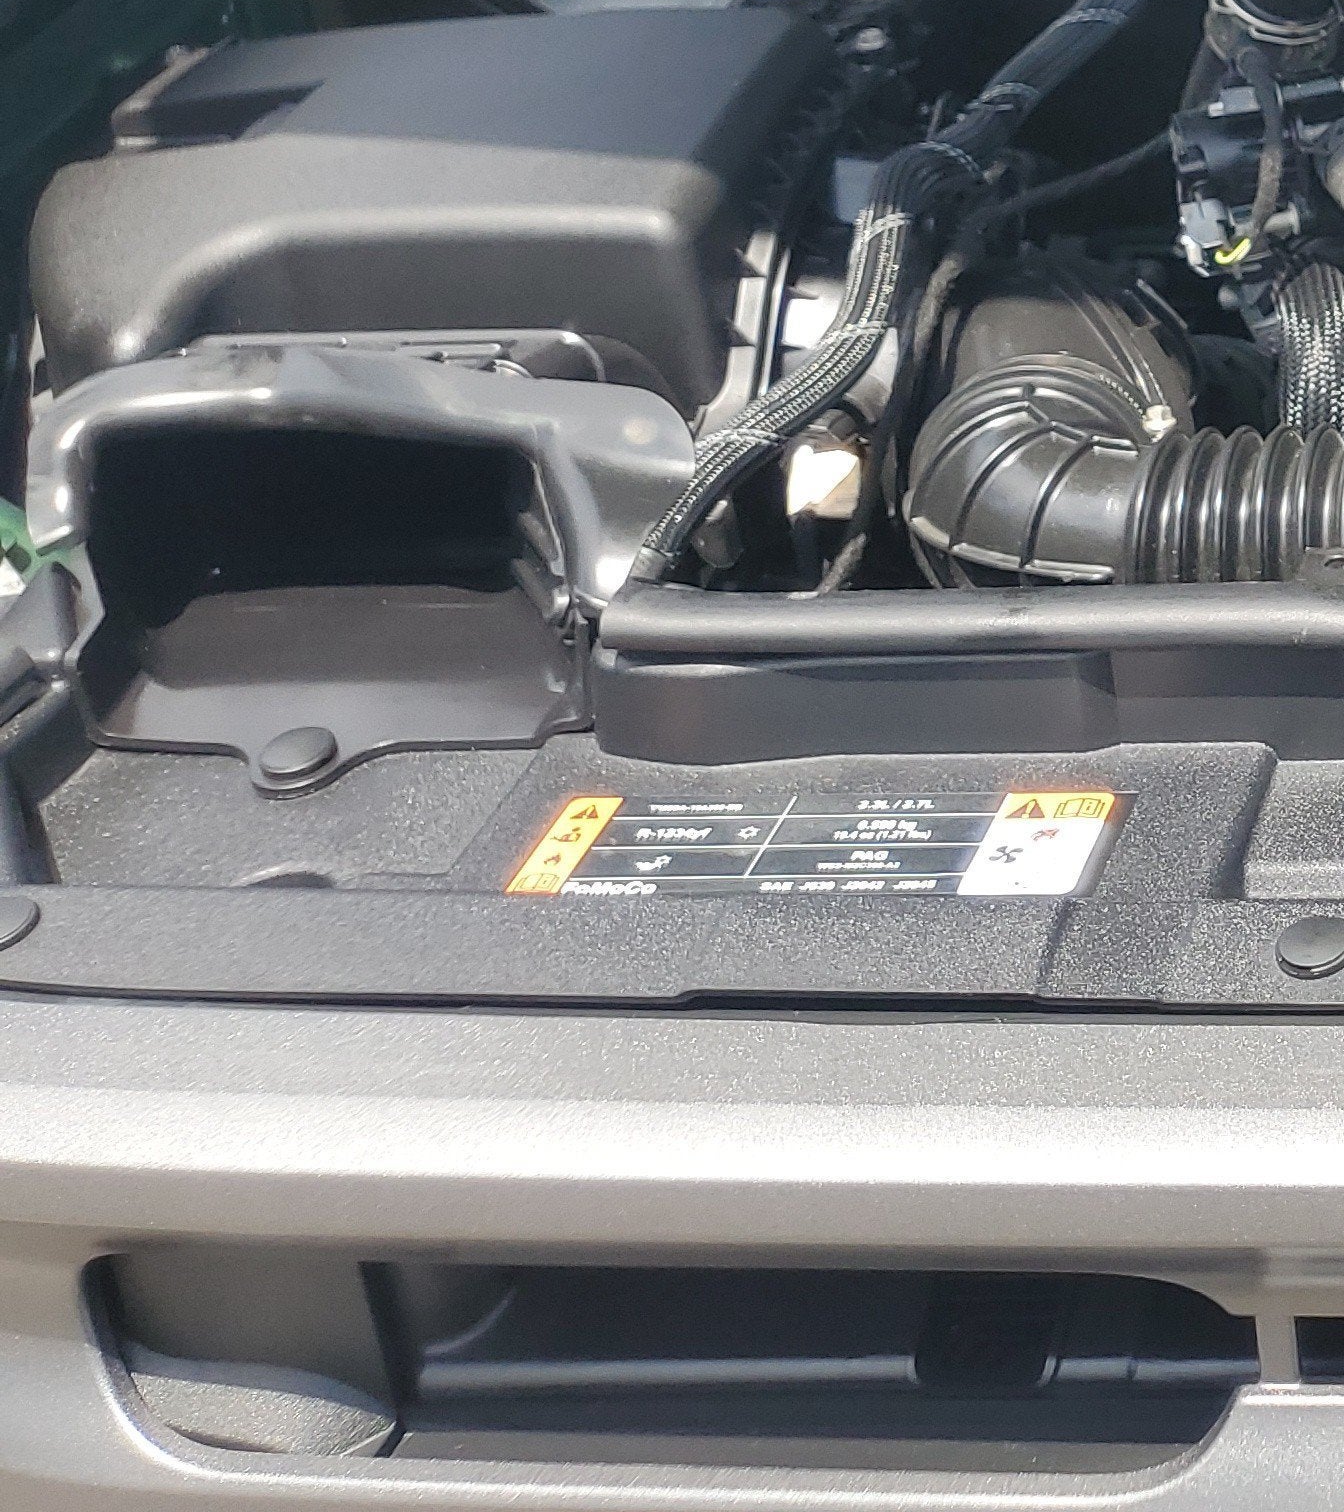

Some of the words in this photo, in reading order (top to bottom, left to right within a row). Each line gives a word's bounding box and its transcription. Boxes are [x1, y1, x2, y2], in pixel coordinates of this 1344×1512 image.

[850, 850, 890, 861] PAG
[560, 880, 658, 895] FoMoCo
[759, 881, 795, 891] SAE
